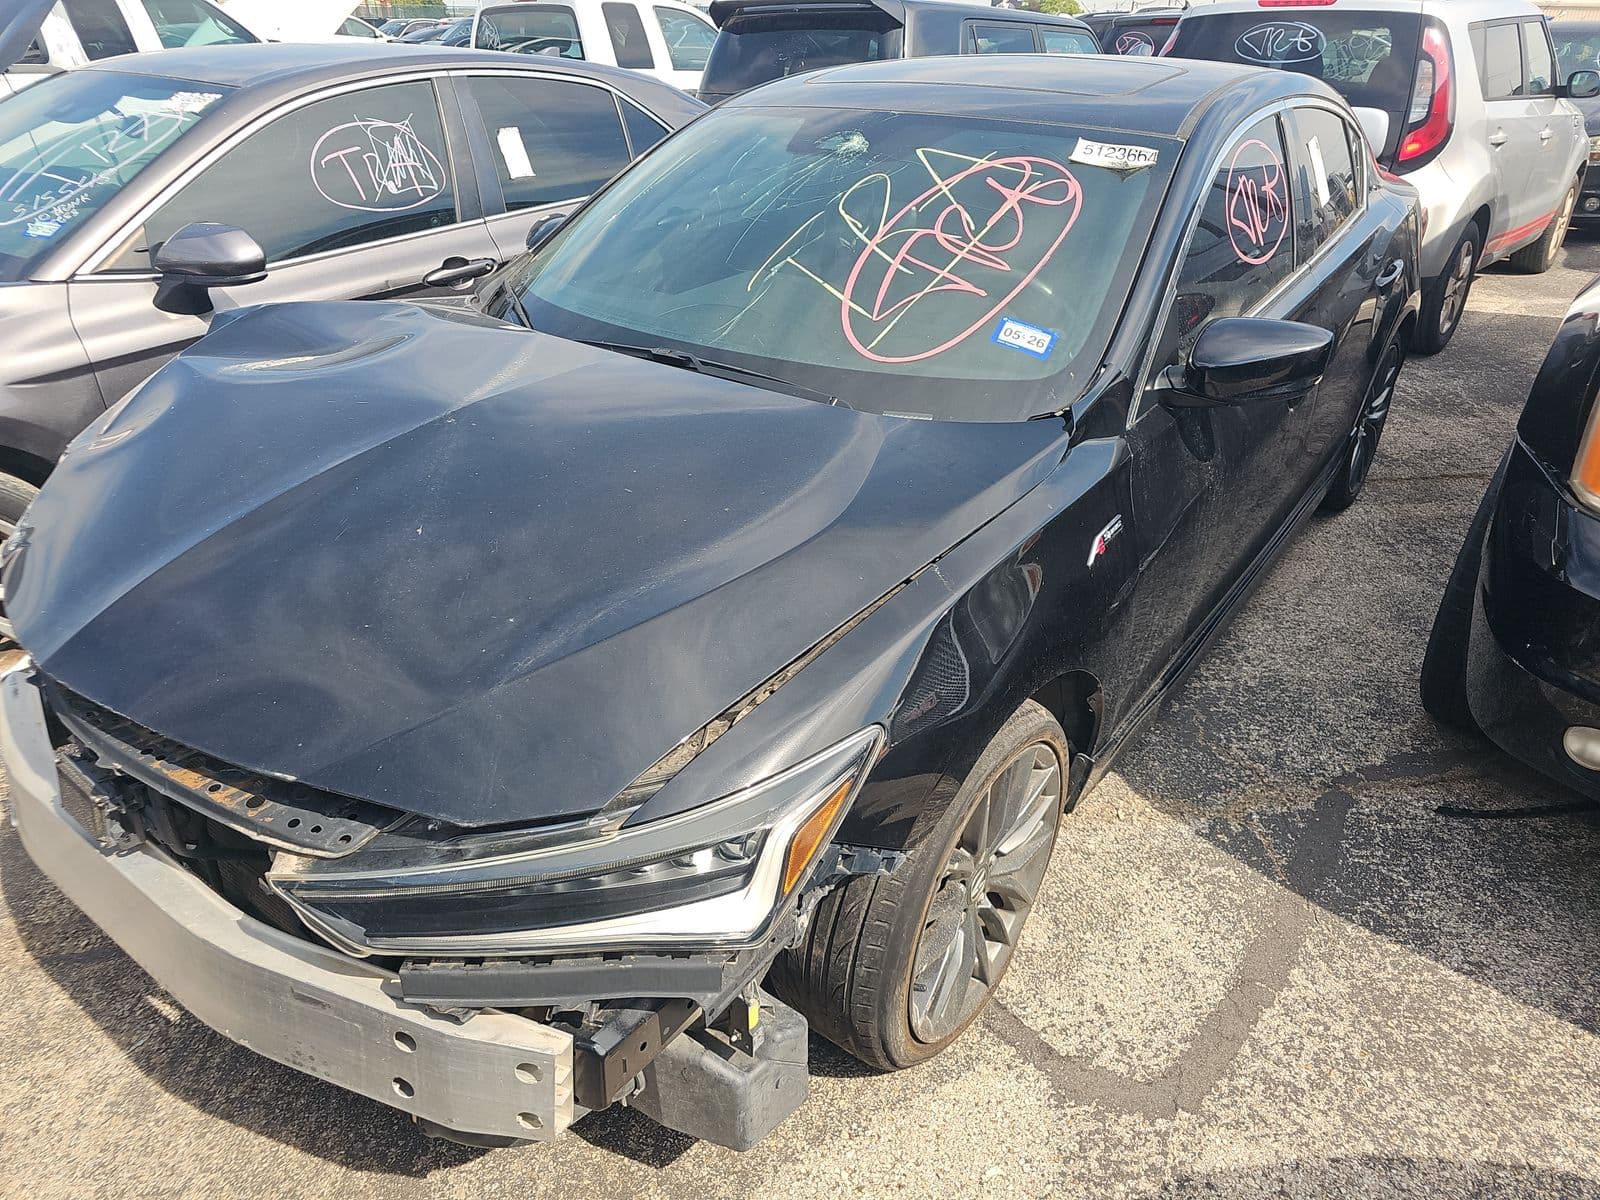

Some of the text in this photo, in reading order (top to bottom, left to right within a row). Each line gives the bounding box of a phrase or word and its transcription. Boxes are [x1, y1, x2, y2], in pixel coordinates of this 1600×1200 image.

[1083, 144, 1157, 162] 5123664
[1003, 327, 1022, 340] 05
[1027, 335, 1046, 349] 26
